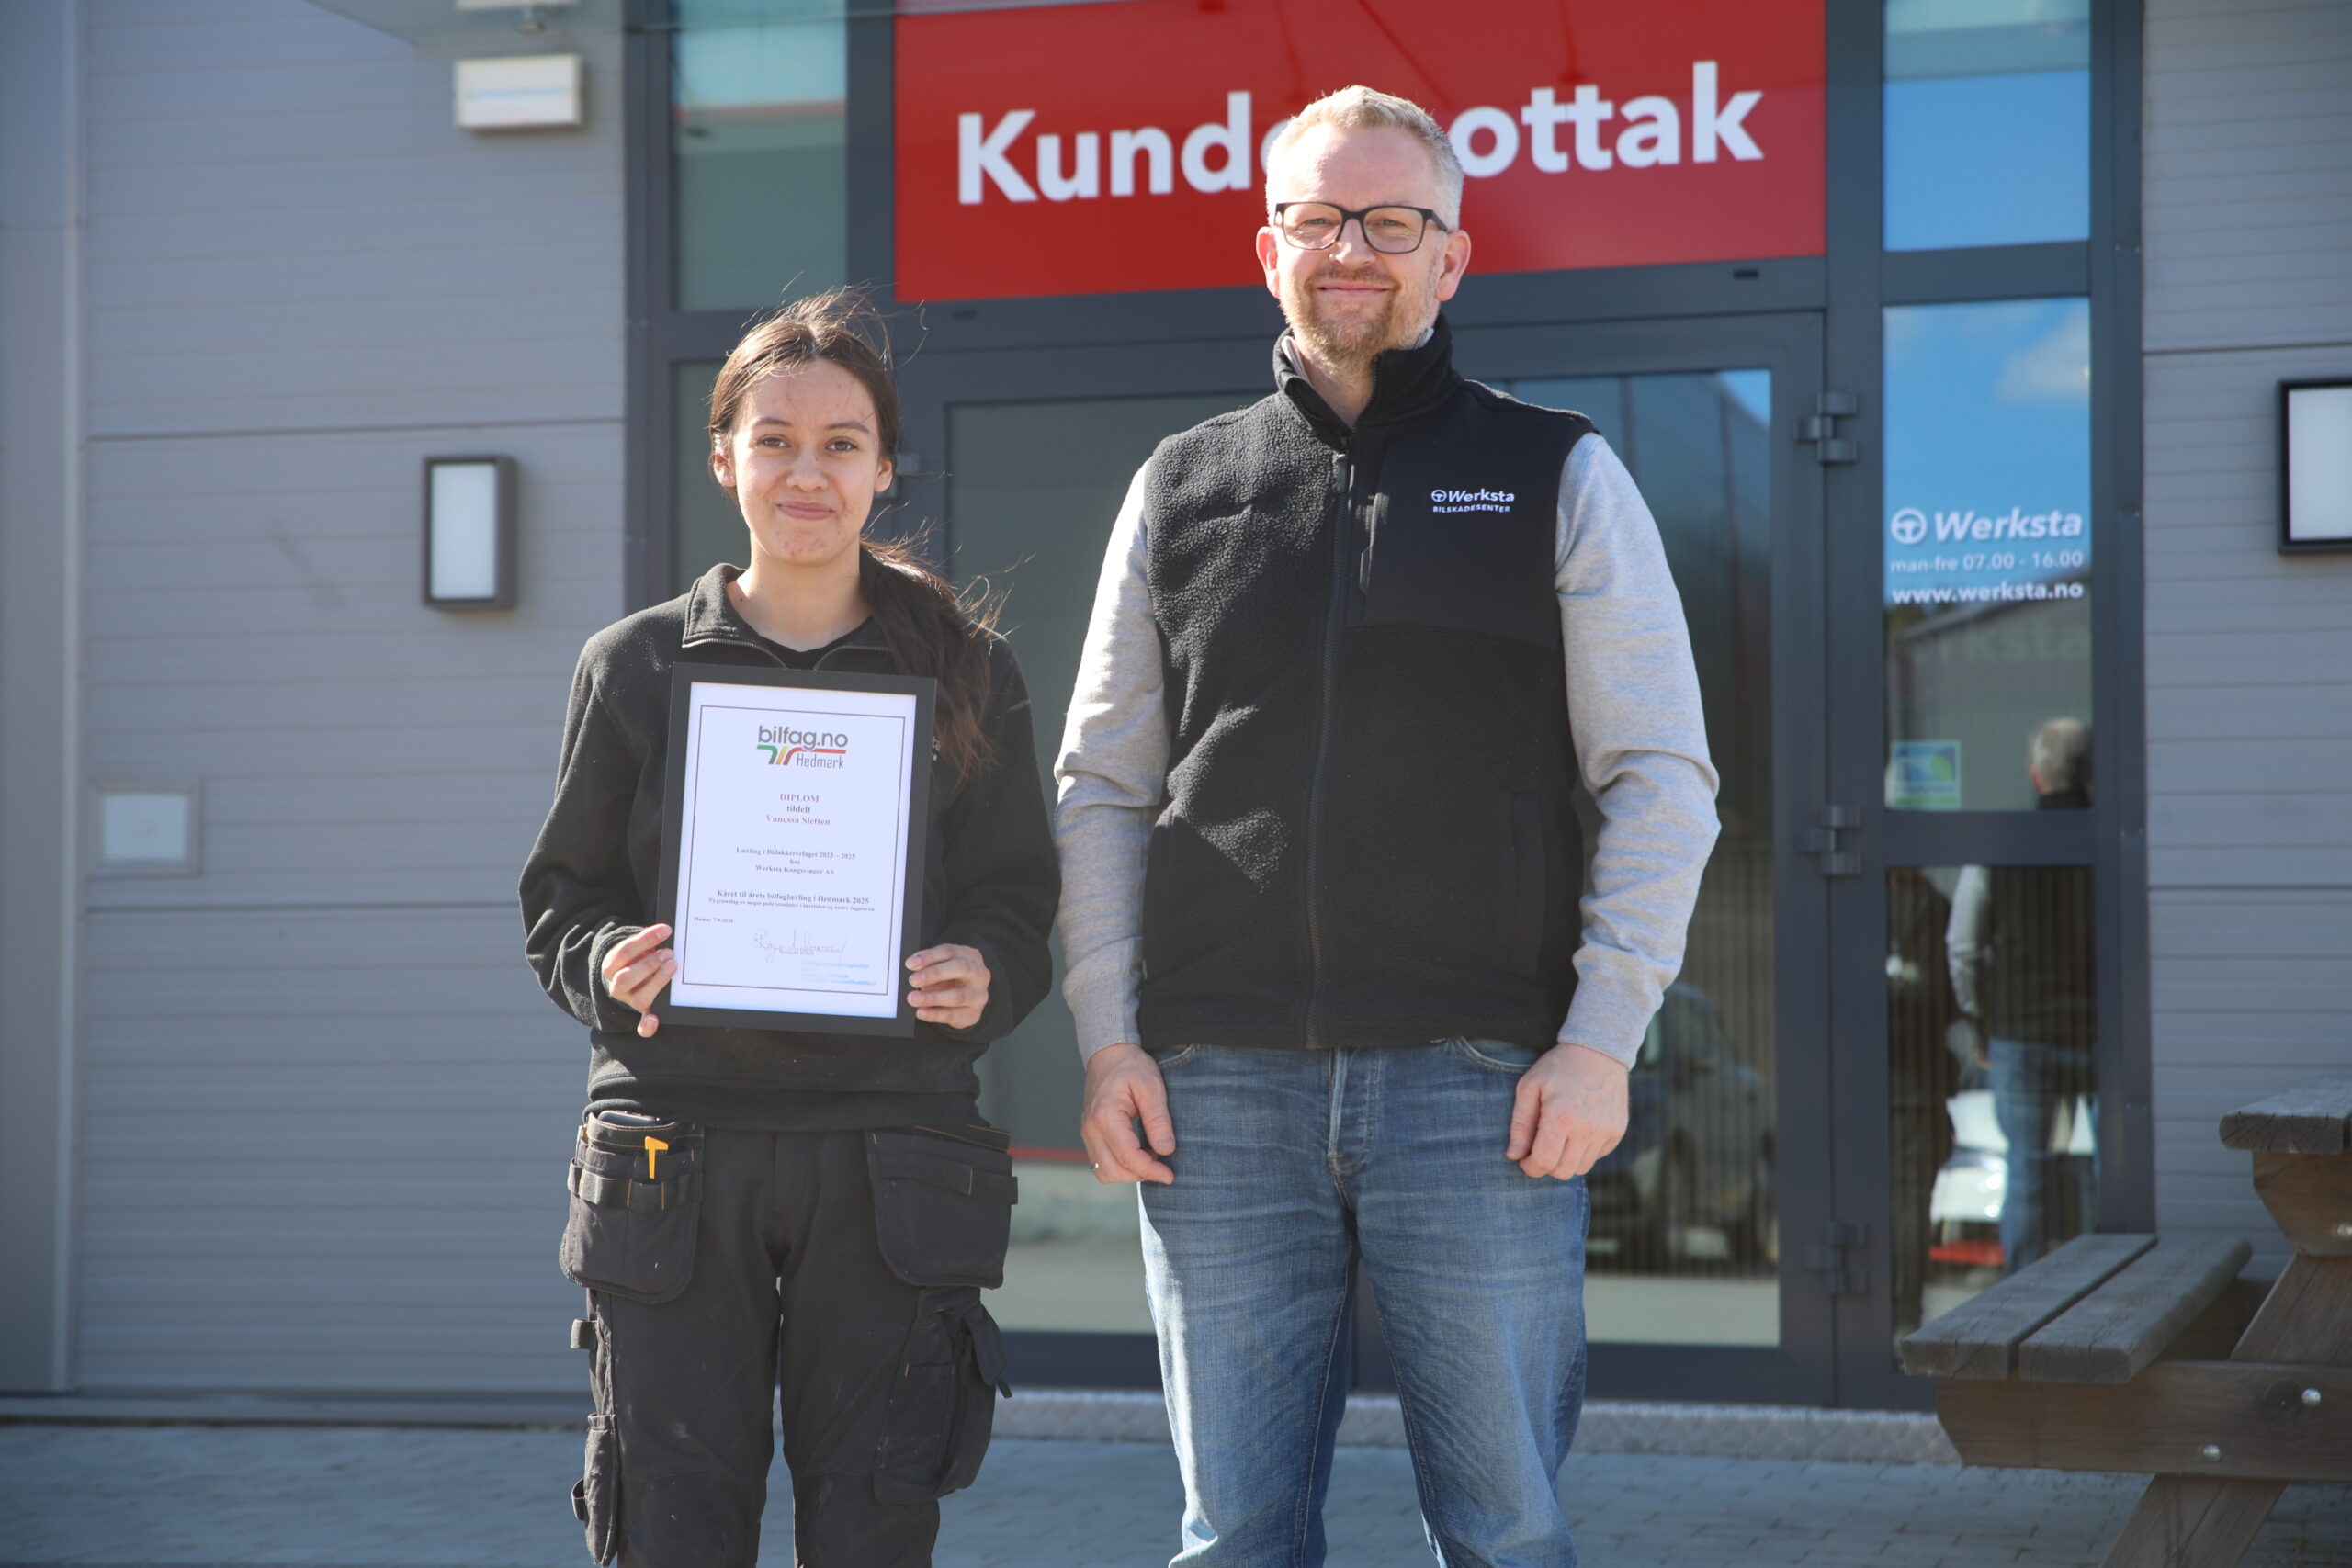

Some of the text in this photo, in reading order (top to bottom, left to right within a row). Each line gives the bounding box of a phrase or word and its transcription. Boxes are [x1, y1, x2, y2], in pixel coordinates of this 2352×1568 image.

[958, 60, 1764, 205] Kundottak
[1448, 488, 1515, 502] Werksta
[1433, 503, 1511, 513] BILSKADESENTER
[1934, 507, 2083, 542] Werksta
[1891, 555, 1958, 573] man-fre
[1963, 553, 2015, 570] 07.00
[2031, 550, 2084, 569] 16.00
[1893, 581, 2085, 604] www.werksta.no
[758, 726, 848, 750] bilfag.no
[797, 753, 844, 770] Hedmark
[780, 793, 820, 803] DIPLOM
[786, 805, 811, 813] tildelt
[766, 814, 831, 826] Vanessa Sletten
[736, 847, 762, 856] Lærling
[755, 864, 783, 873] Werksta
[717, 889, 738, 897] Kåret
[818, 895, 851, 903] Hedmark
[853, 897, 870, 905] 2025
